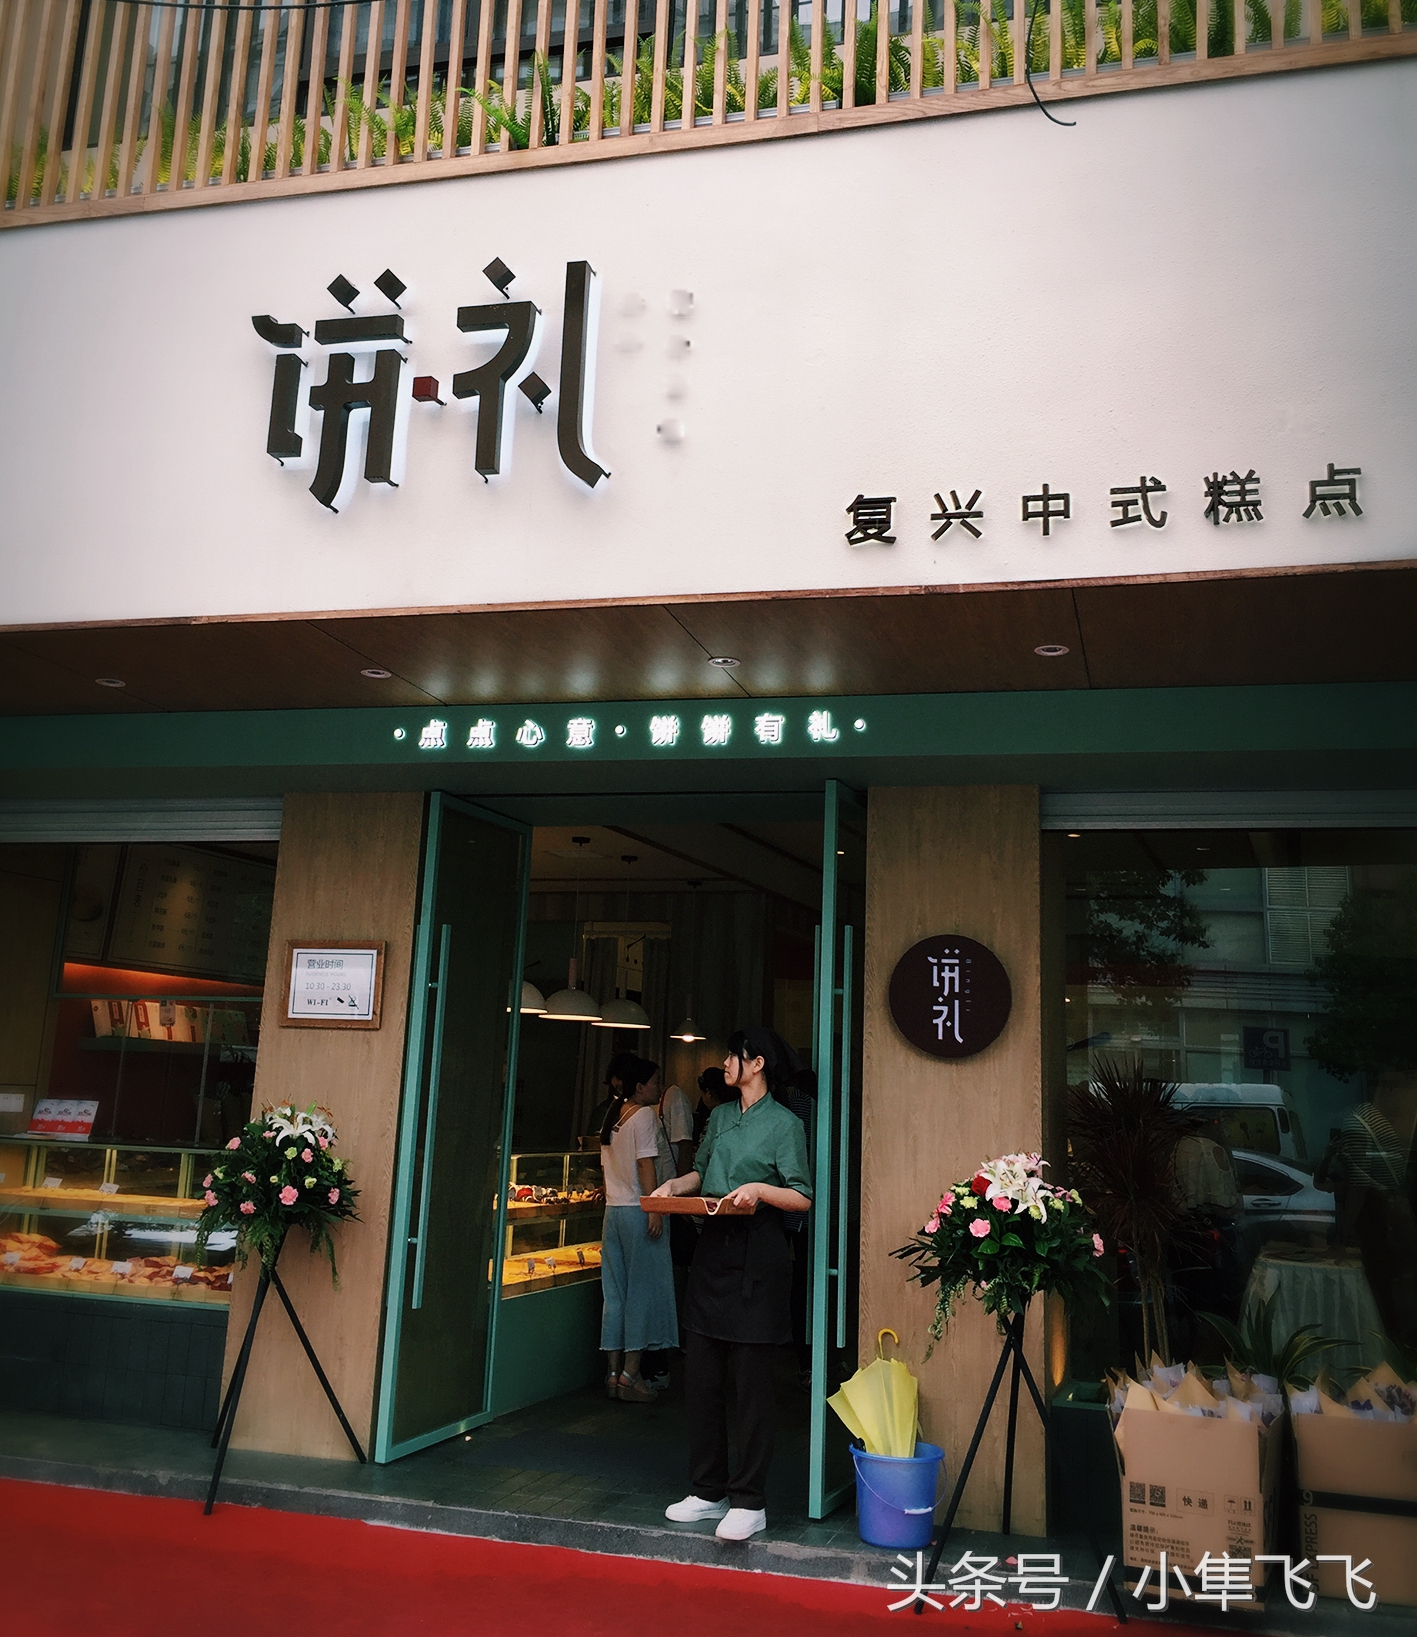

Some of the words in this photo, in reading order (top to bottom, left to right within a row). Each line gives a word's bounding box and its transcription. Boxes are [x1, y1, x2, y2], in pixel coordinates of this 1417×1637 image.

[845, 463, 1363, 545] 复兴中式糕点
[307, 959, 344, 969] 营业时间
[305, 982, 326, 990] 1030
[1182, 1495, 1209, 1510] 快递
